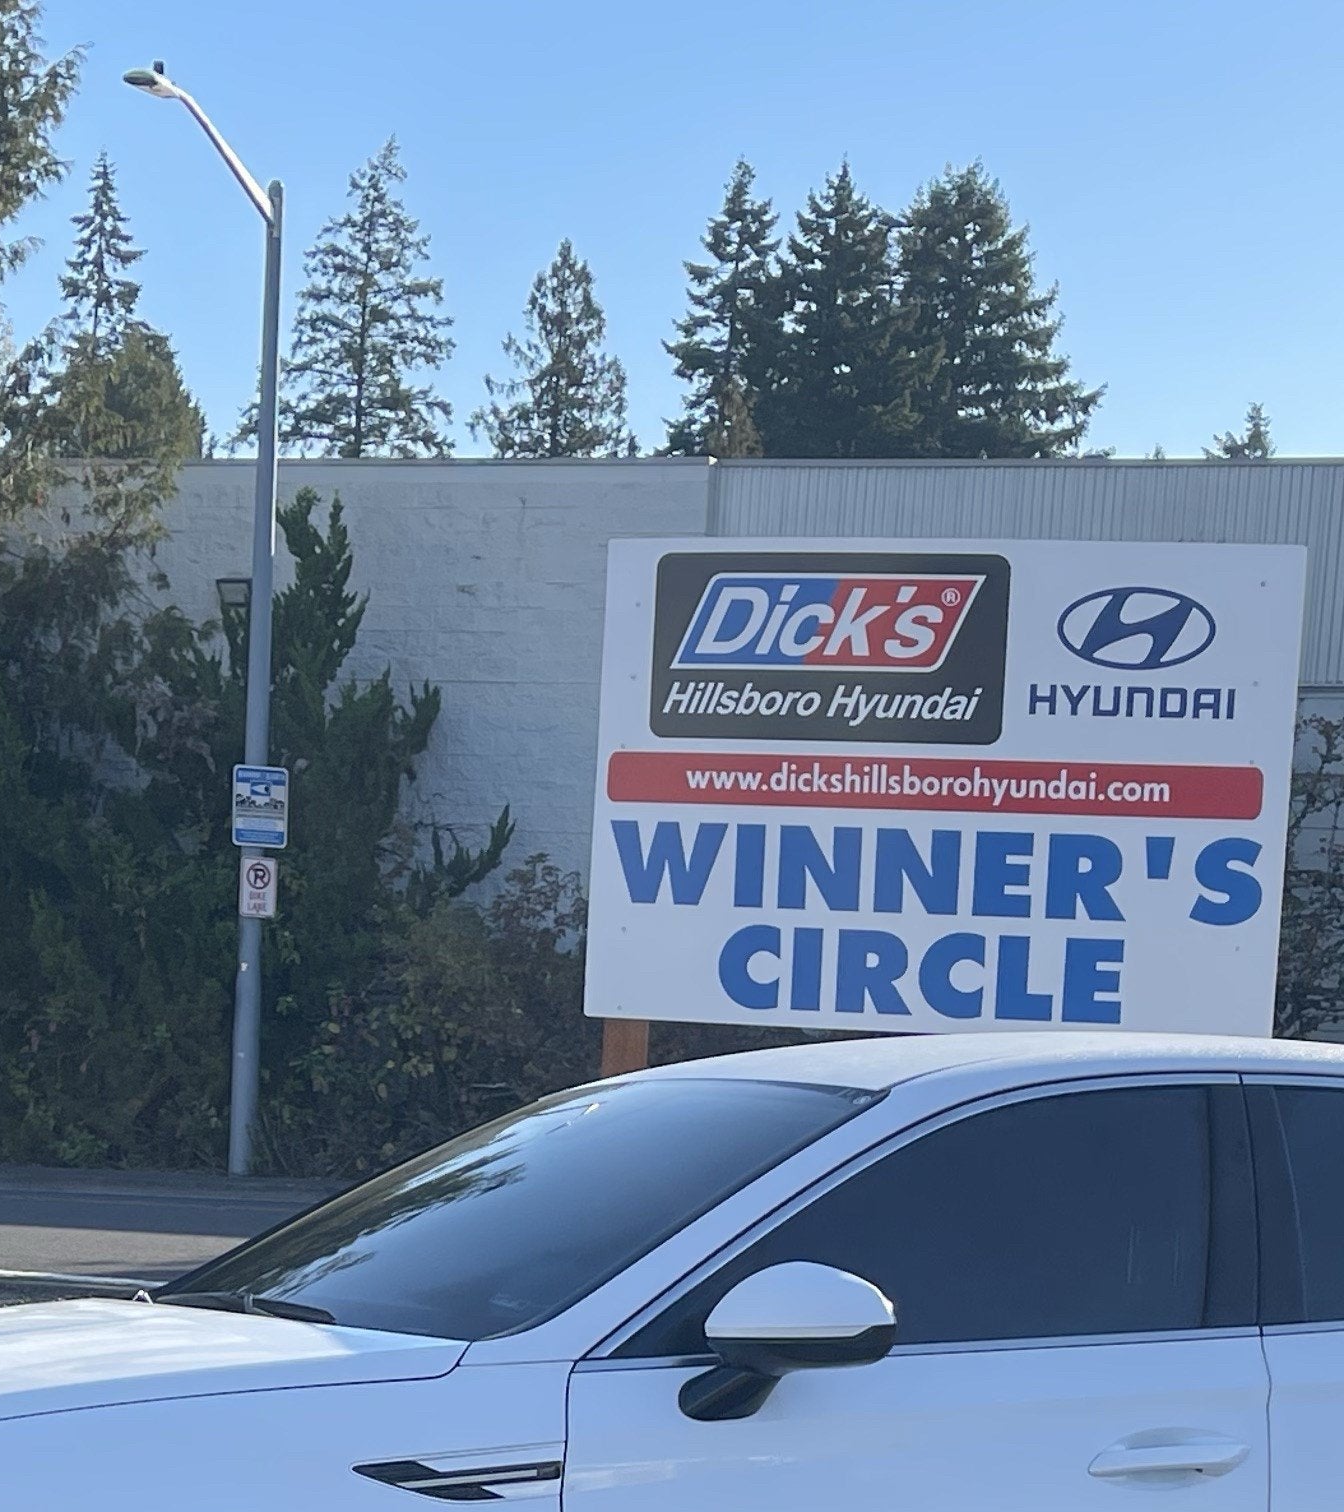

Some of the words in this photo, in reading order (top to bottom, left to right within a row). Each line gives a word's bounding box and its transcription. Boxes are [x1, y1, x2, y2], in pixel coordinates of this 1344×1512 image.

[694, 583, 944, 659] Dick's
[662, 681, 822, 718] Hillsboro
[827, 684, 984, 727] Hyundai
[1028, 683, 1236, 720] HYUNDAI
[686, 763, 1171, 808] www.dickshillsborohyundai.com
[610, 819, 1264, 927] WINNER'S
[717, 924, 1126, 1025] CIRCLE
